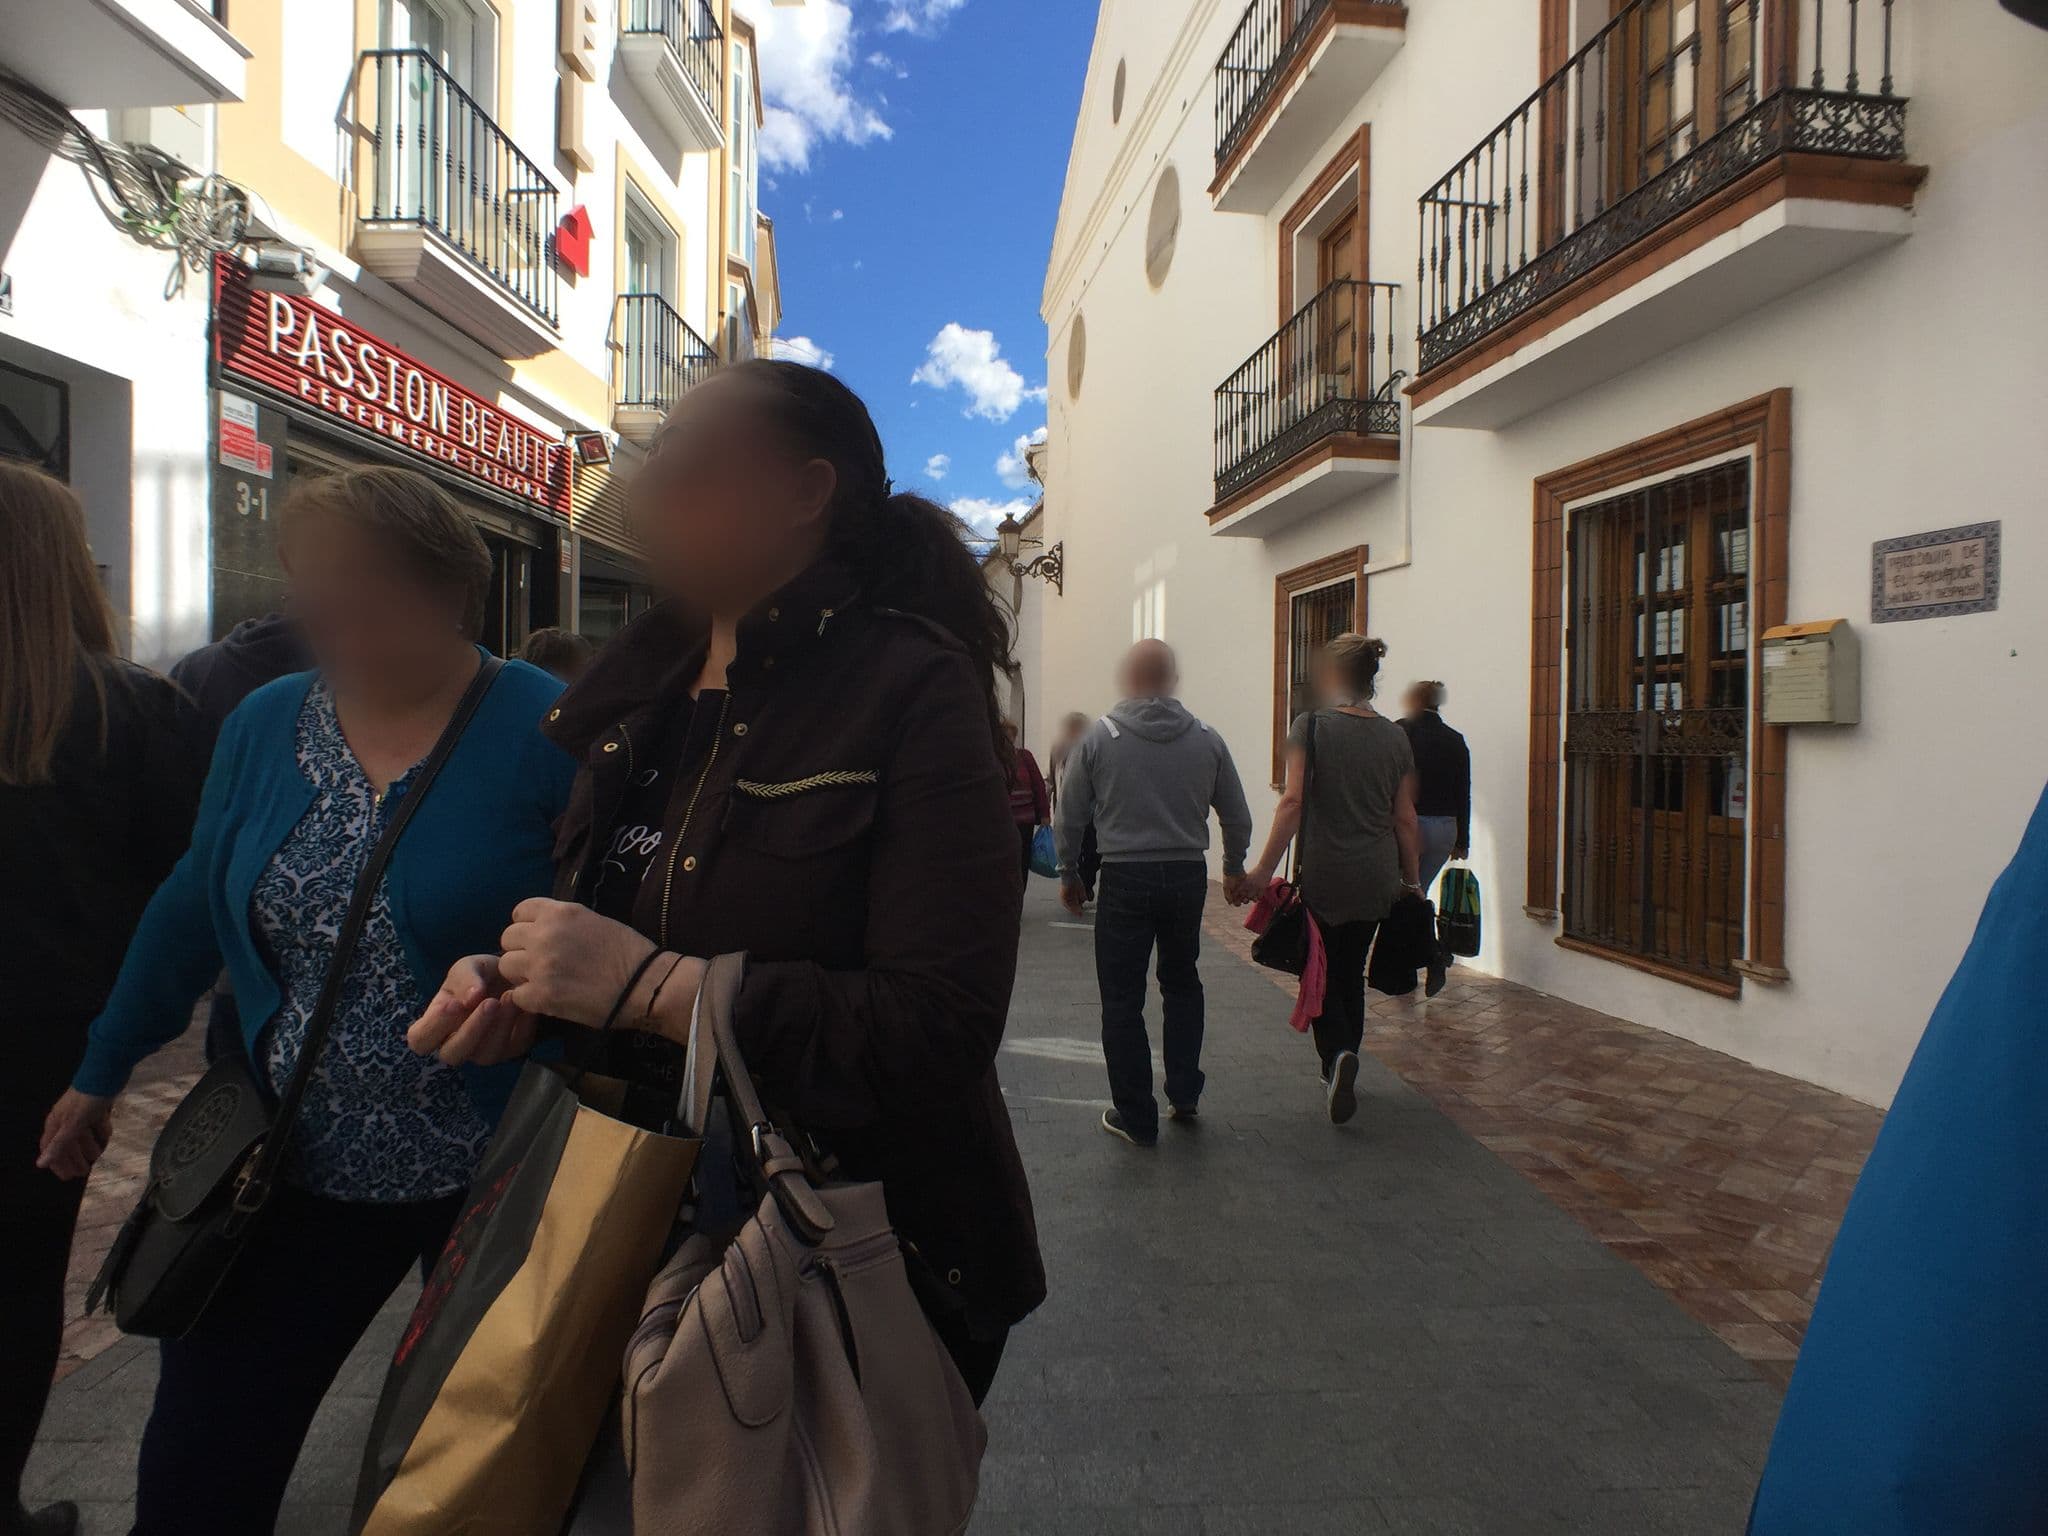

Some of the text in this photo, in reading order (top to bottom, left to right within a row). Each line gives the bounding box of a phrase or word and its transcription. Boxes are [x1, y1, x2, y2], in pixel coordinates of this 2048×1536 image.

[267, 292, 557, 486] PASSION BEAUTE
[297, 377, 458, 463] PERFUMERIA
